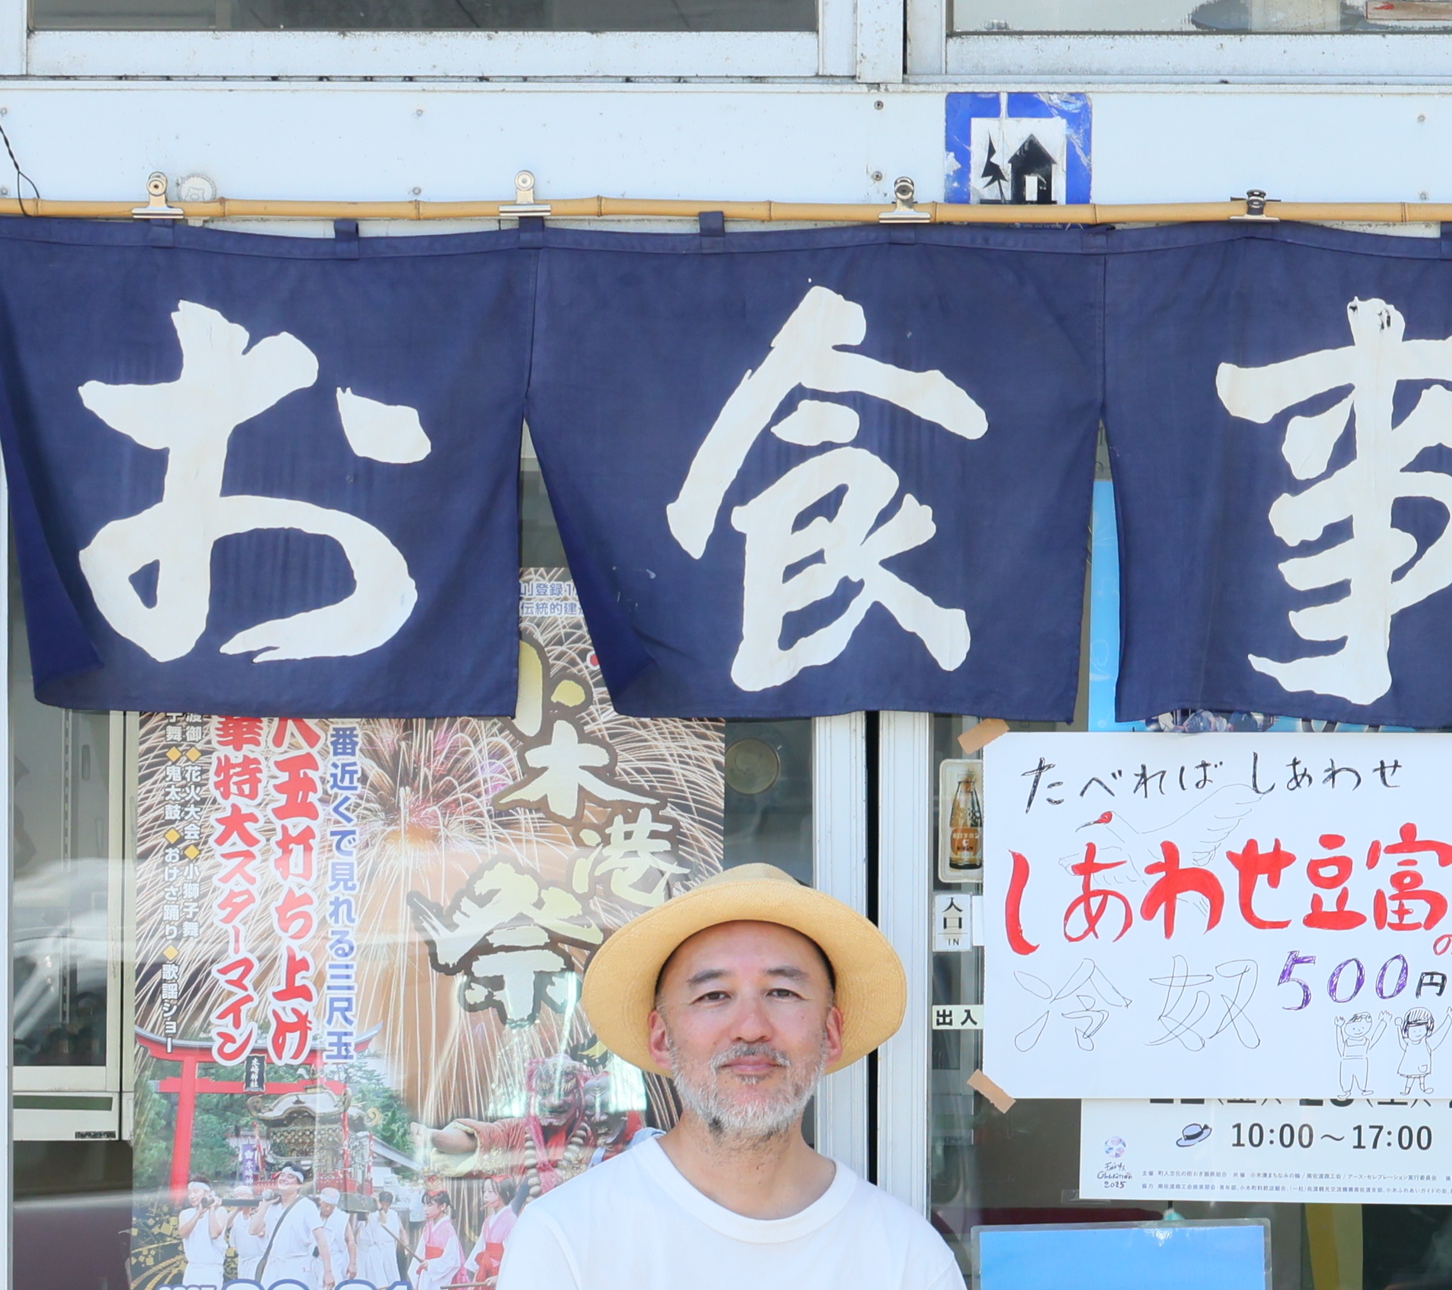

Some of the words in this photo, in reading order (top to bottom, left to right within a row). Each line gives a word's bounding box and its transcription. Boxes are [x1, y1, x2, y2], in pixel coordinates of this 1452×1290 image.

[520, 602, 584, 616] 伝統的建
[1021, 756, 1225, 813] たべれば
[1250, 751, 1404, 795] しあわせ
[943, 898, 963, 929] 入口
[948, 938, 960, 946] IN
[1013, 955, 1260, 1053] 冷奴
[1276, 950, 1448, 1013] 500円
[936, 1010, 978, 1027] 出入
[1104, 1181, 1127, 1189] 2025
